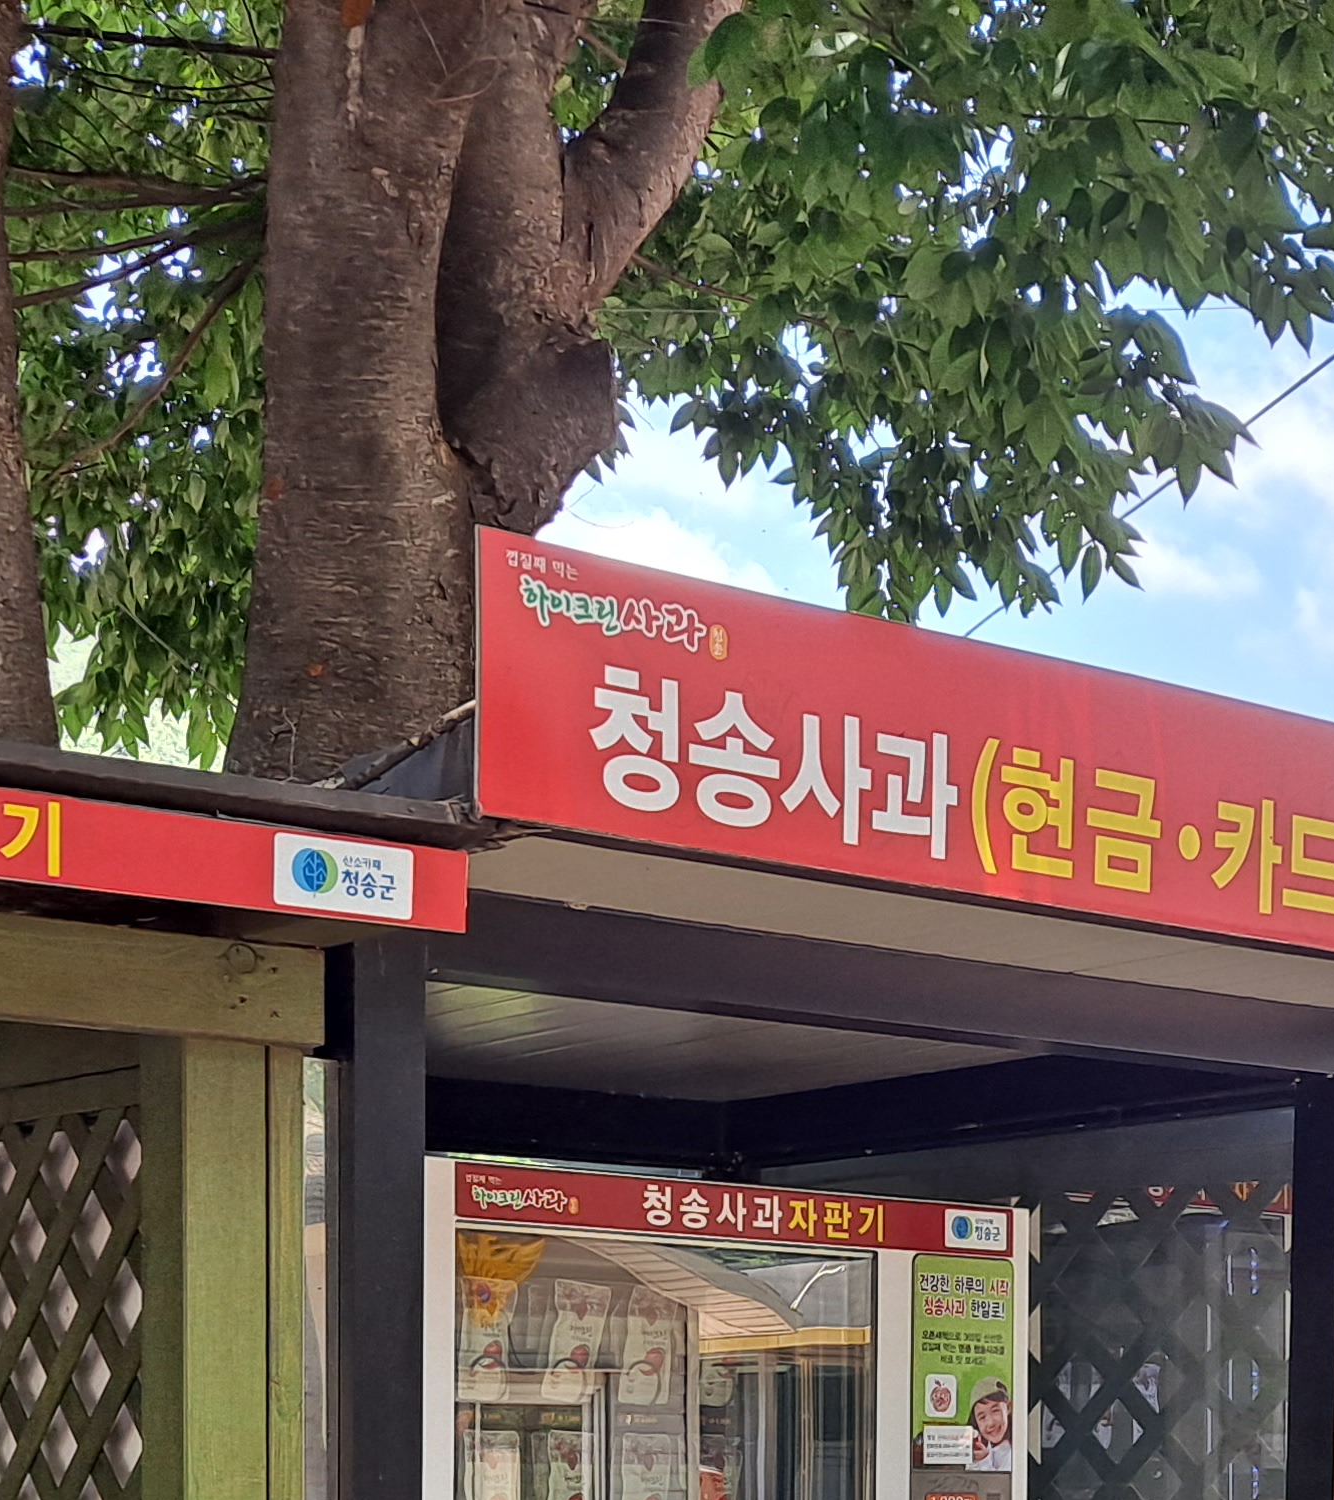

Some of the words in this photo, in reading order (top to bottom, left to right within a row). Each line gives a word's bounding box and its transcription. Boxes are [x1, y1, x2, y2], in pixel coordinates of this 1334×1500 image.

[552, 560, 579, 581] 먹는
[341, 869, 397, 901] 청송군
[919, 1274, 950, 1293] 건강한
[954, 1276, 985, 1295] 하루의
[990, 1280, 1010, 1296] 시작
[923, 1297, 966, 1317] 청송사과
